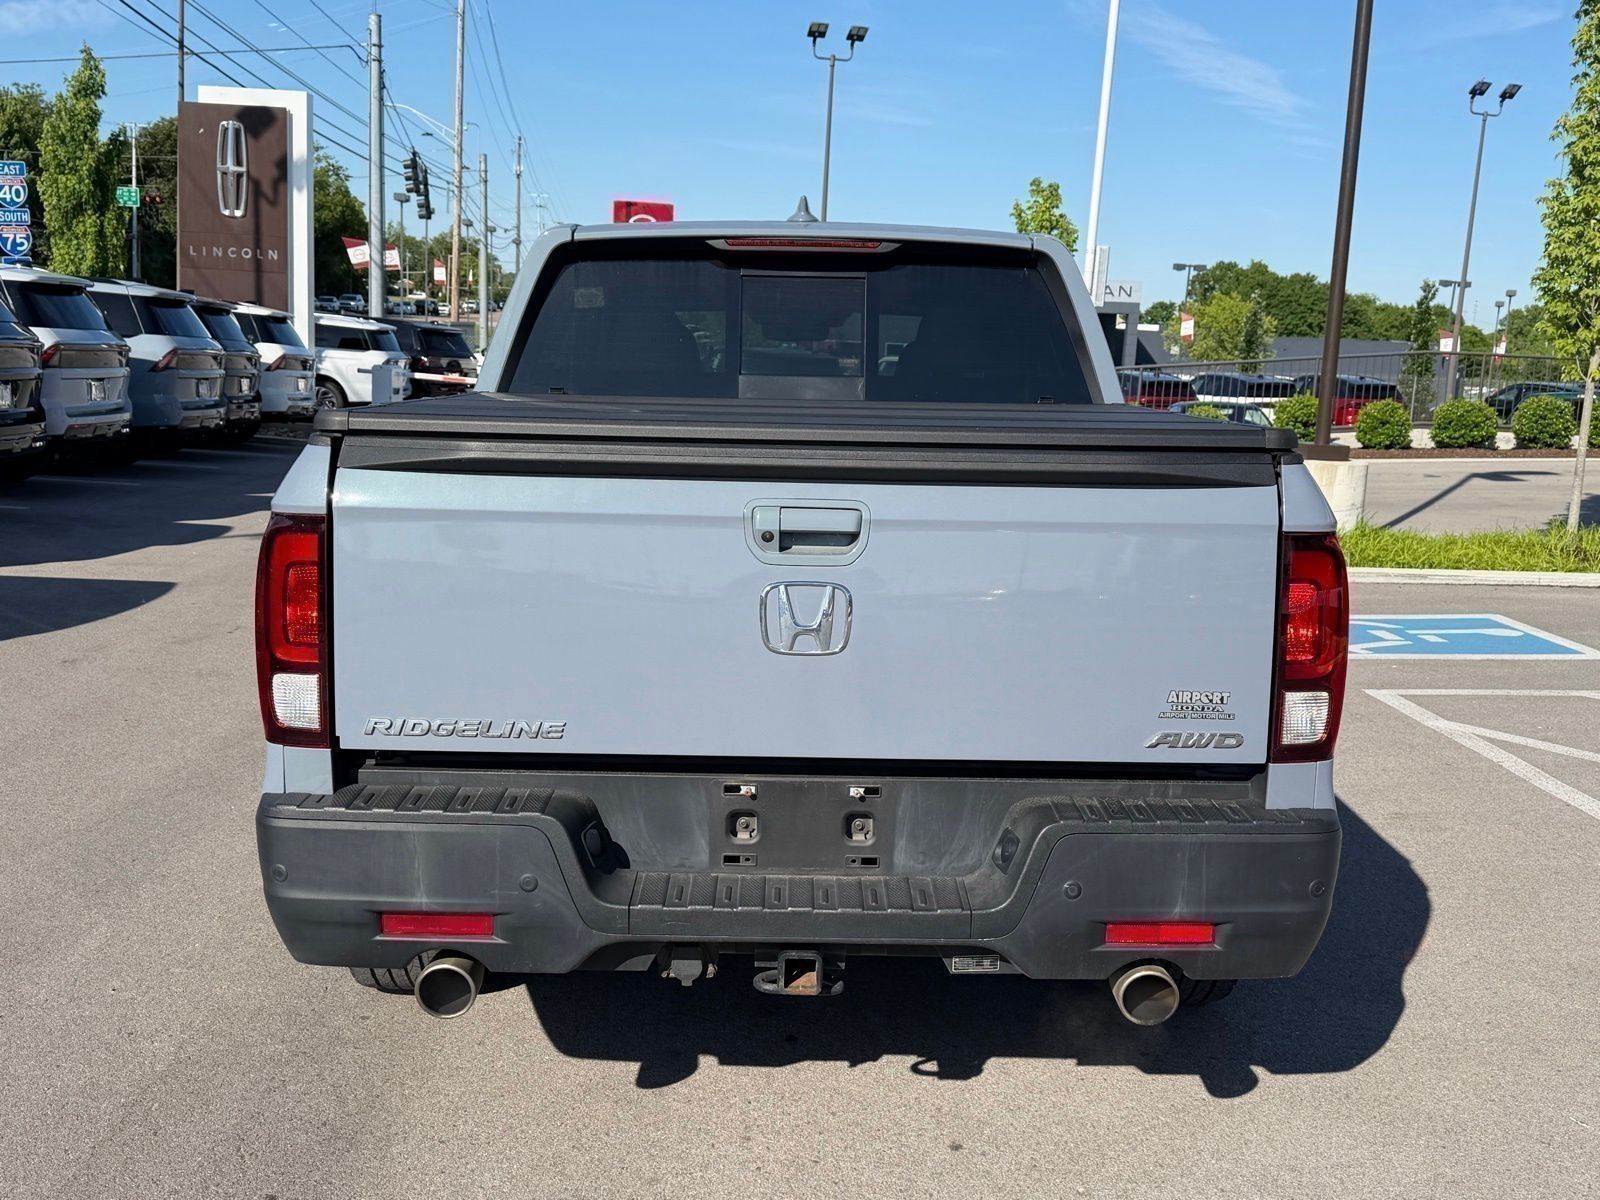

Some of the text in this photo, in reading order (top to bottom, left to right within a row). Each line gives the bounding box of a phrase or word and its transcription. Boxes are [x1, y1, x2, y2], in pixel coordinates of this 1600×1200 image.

[0, 164, 20, 174] EAST
[0, 185, 24, 202] 40
[0, 212, 28, 221] SOUTH
[2, 234, 28, 250] 75
[189, 245, 278, 260] LINCOLN
[1167, 690, 1231, 705] AIRPORT
[1171, 704, 1225, 712] HONDA
[364, 717, 567, 739] RIDGELINE
[1143, 731, 1245, 749] AWD
